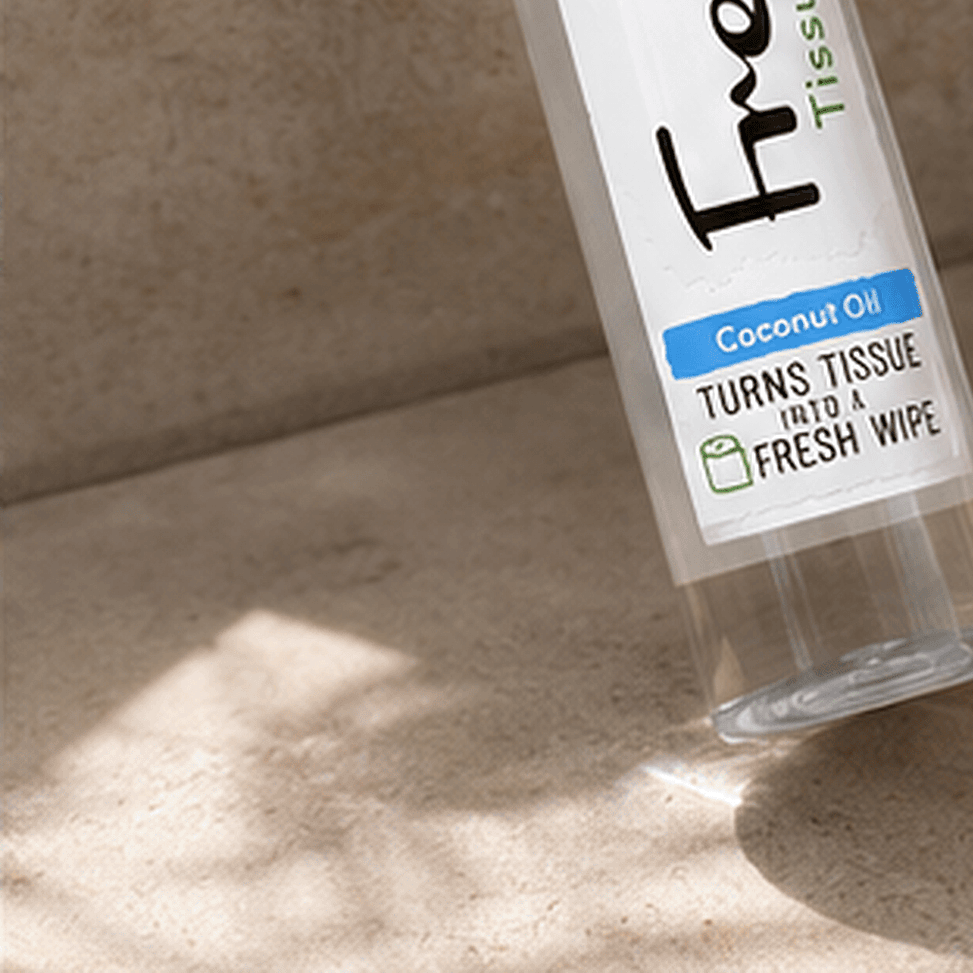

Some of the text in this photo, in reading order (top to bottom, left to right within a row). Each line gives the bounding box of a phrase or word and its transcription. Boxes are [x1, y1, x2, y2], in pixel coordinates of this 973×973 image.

[716, 303, 838, 352] Coconut
[697, 333, 921, 419] TURNS TISSUE
[852, 390, 867, 411] A
[754, 400, 941, 478] FRESH WIPE
